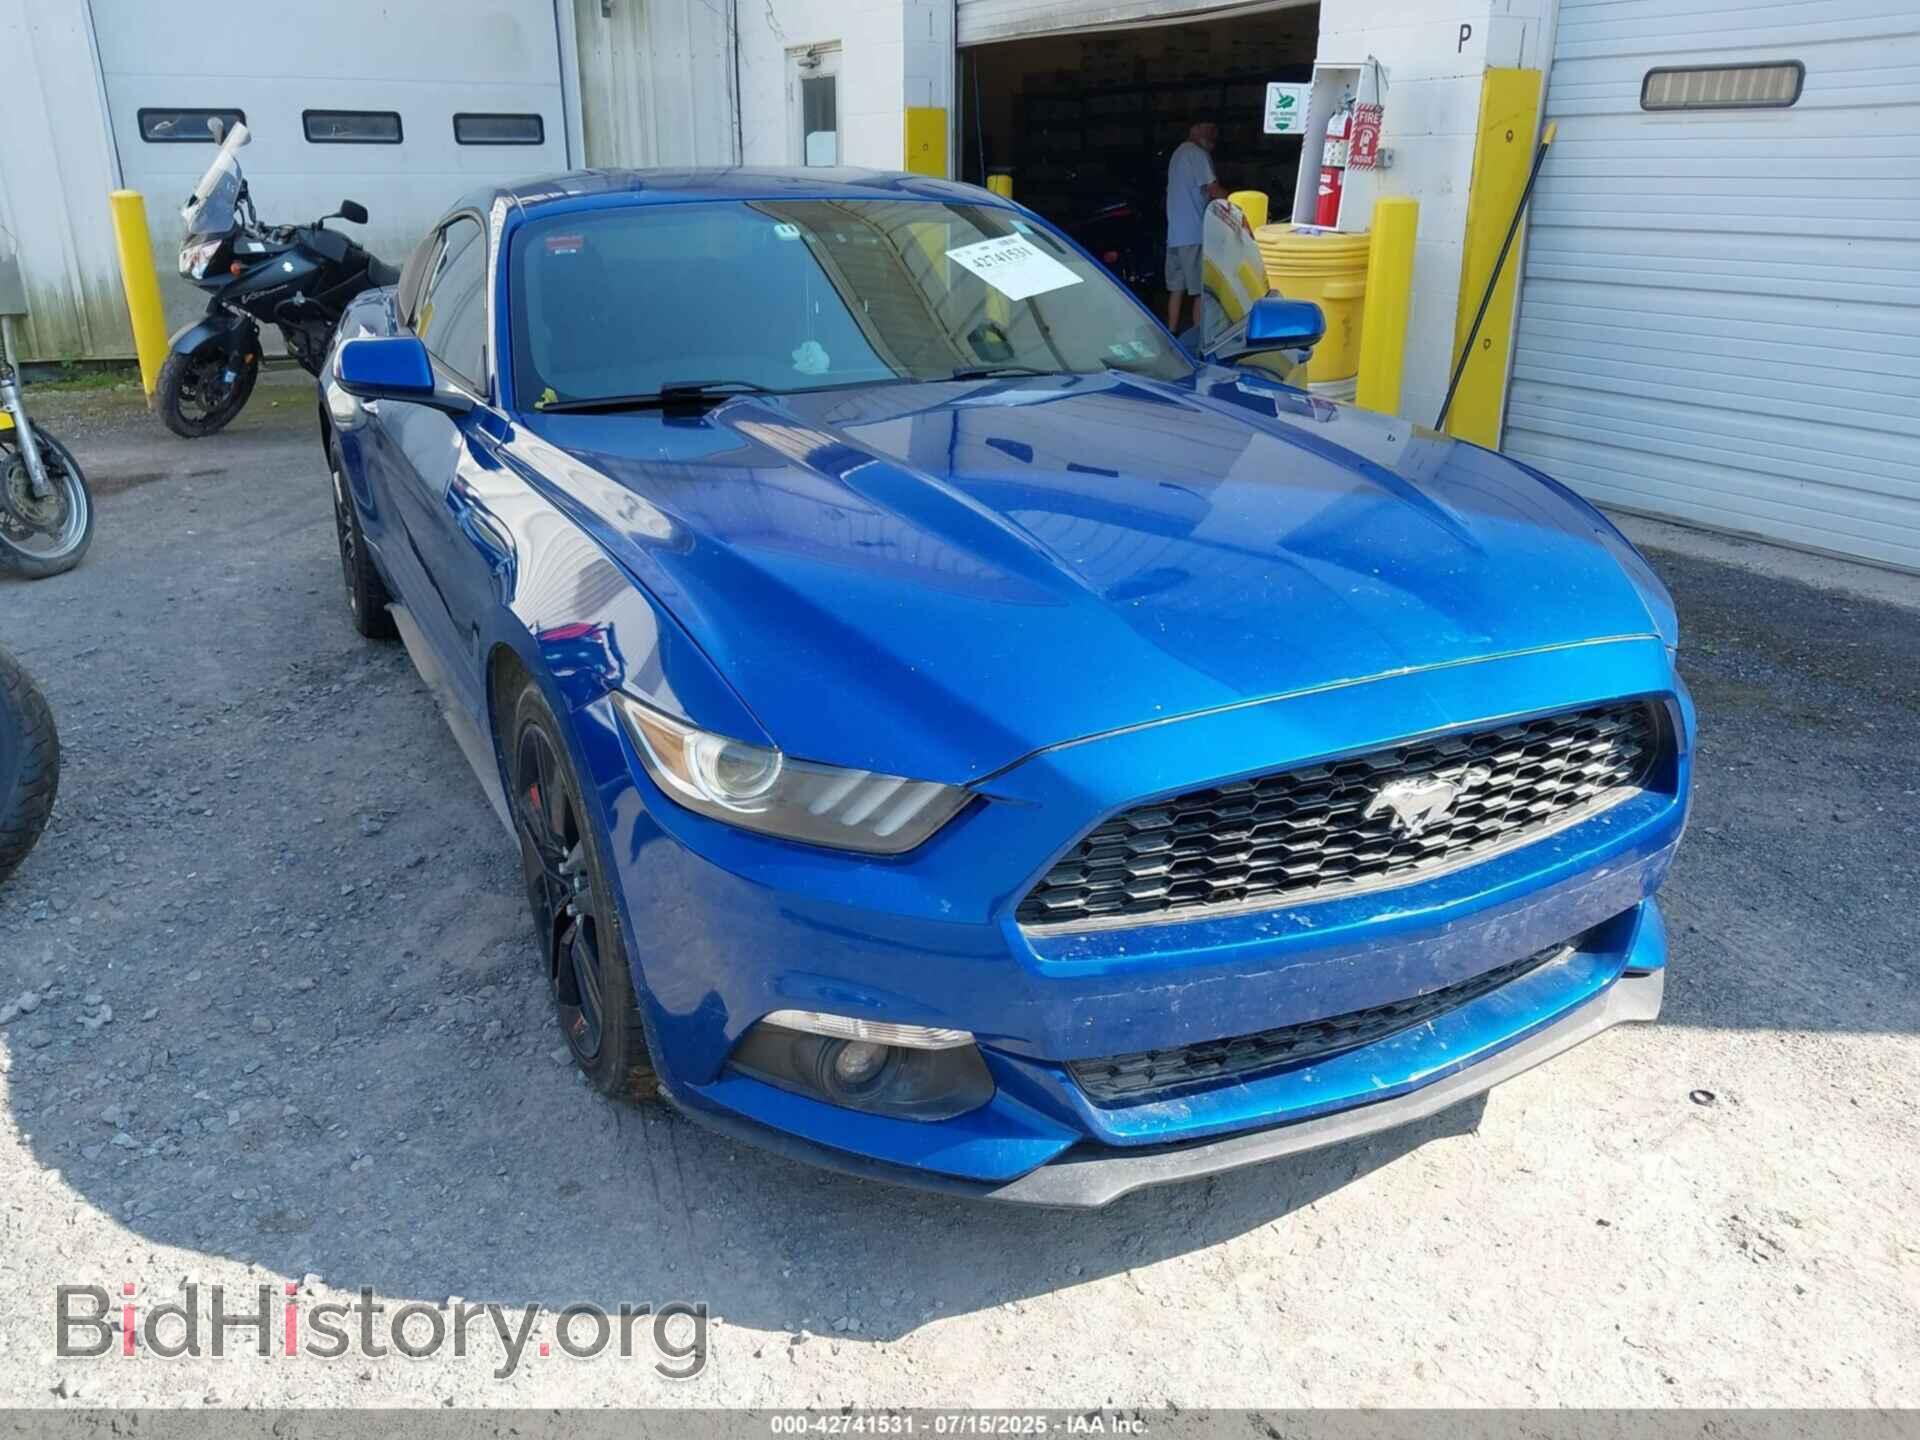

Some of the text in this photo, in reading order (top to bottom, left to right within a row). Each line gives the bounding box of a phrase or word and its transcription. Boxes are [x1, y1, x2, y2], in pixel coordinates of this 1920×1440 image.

[1458, 23, 1472, 54] P
[1358, 111, 1382, 125] FIRE
[972, 246, 1033, 268] 42741531
